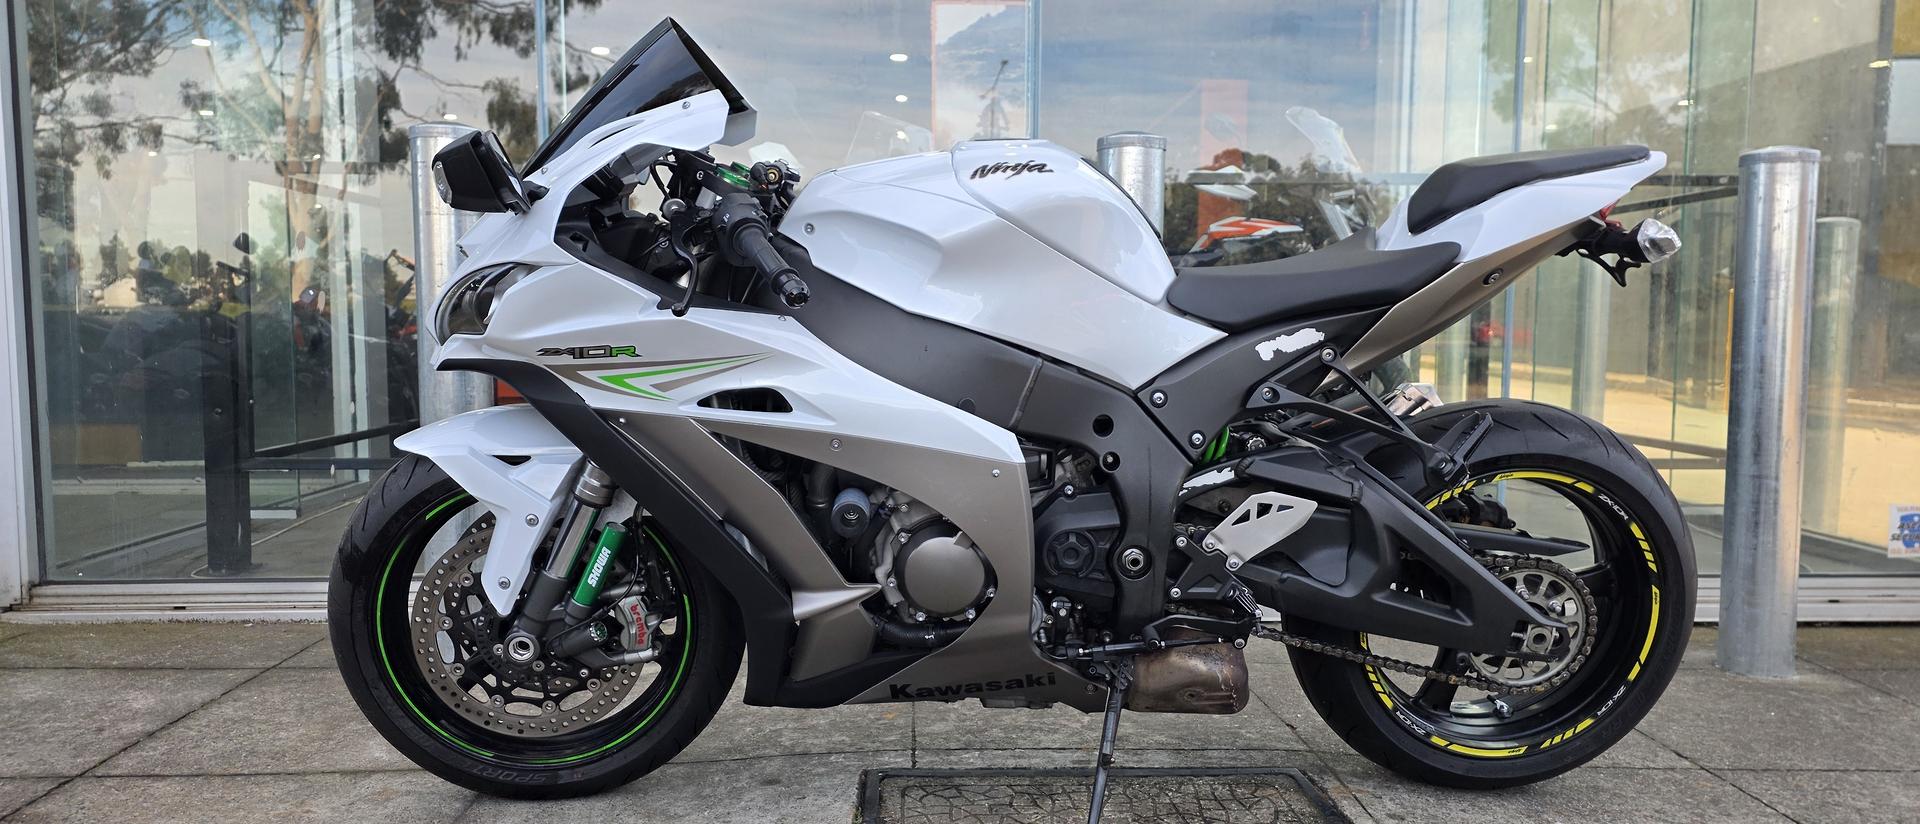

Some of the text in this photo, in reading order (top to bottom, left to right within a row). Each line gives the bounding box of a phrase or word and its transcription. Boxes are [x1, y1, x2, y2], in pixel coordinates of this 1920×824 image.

[970, 160, 1054, 180] Ninja
[587, 546, 612, 588] SHOWA
[630, 603, 647, 645] brembo
[889, 672, 1056, 700] Kawasaki
